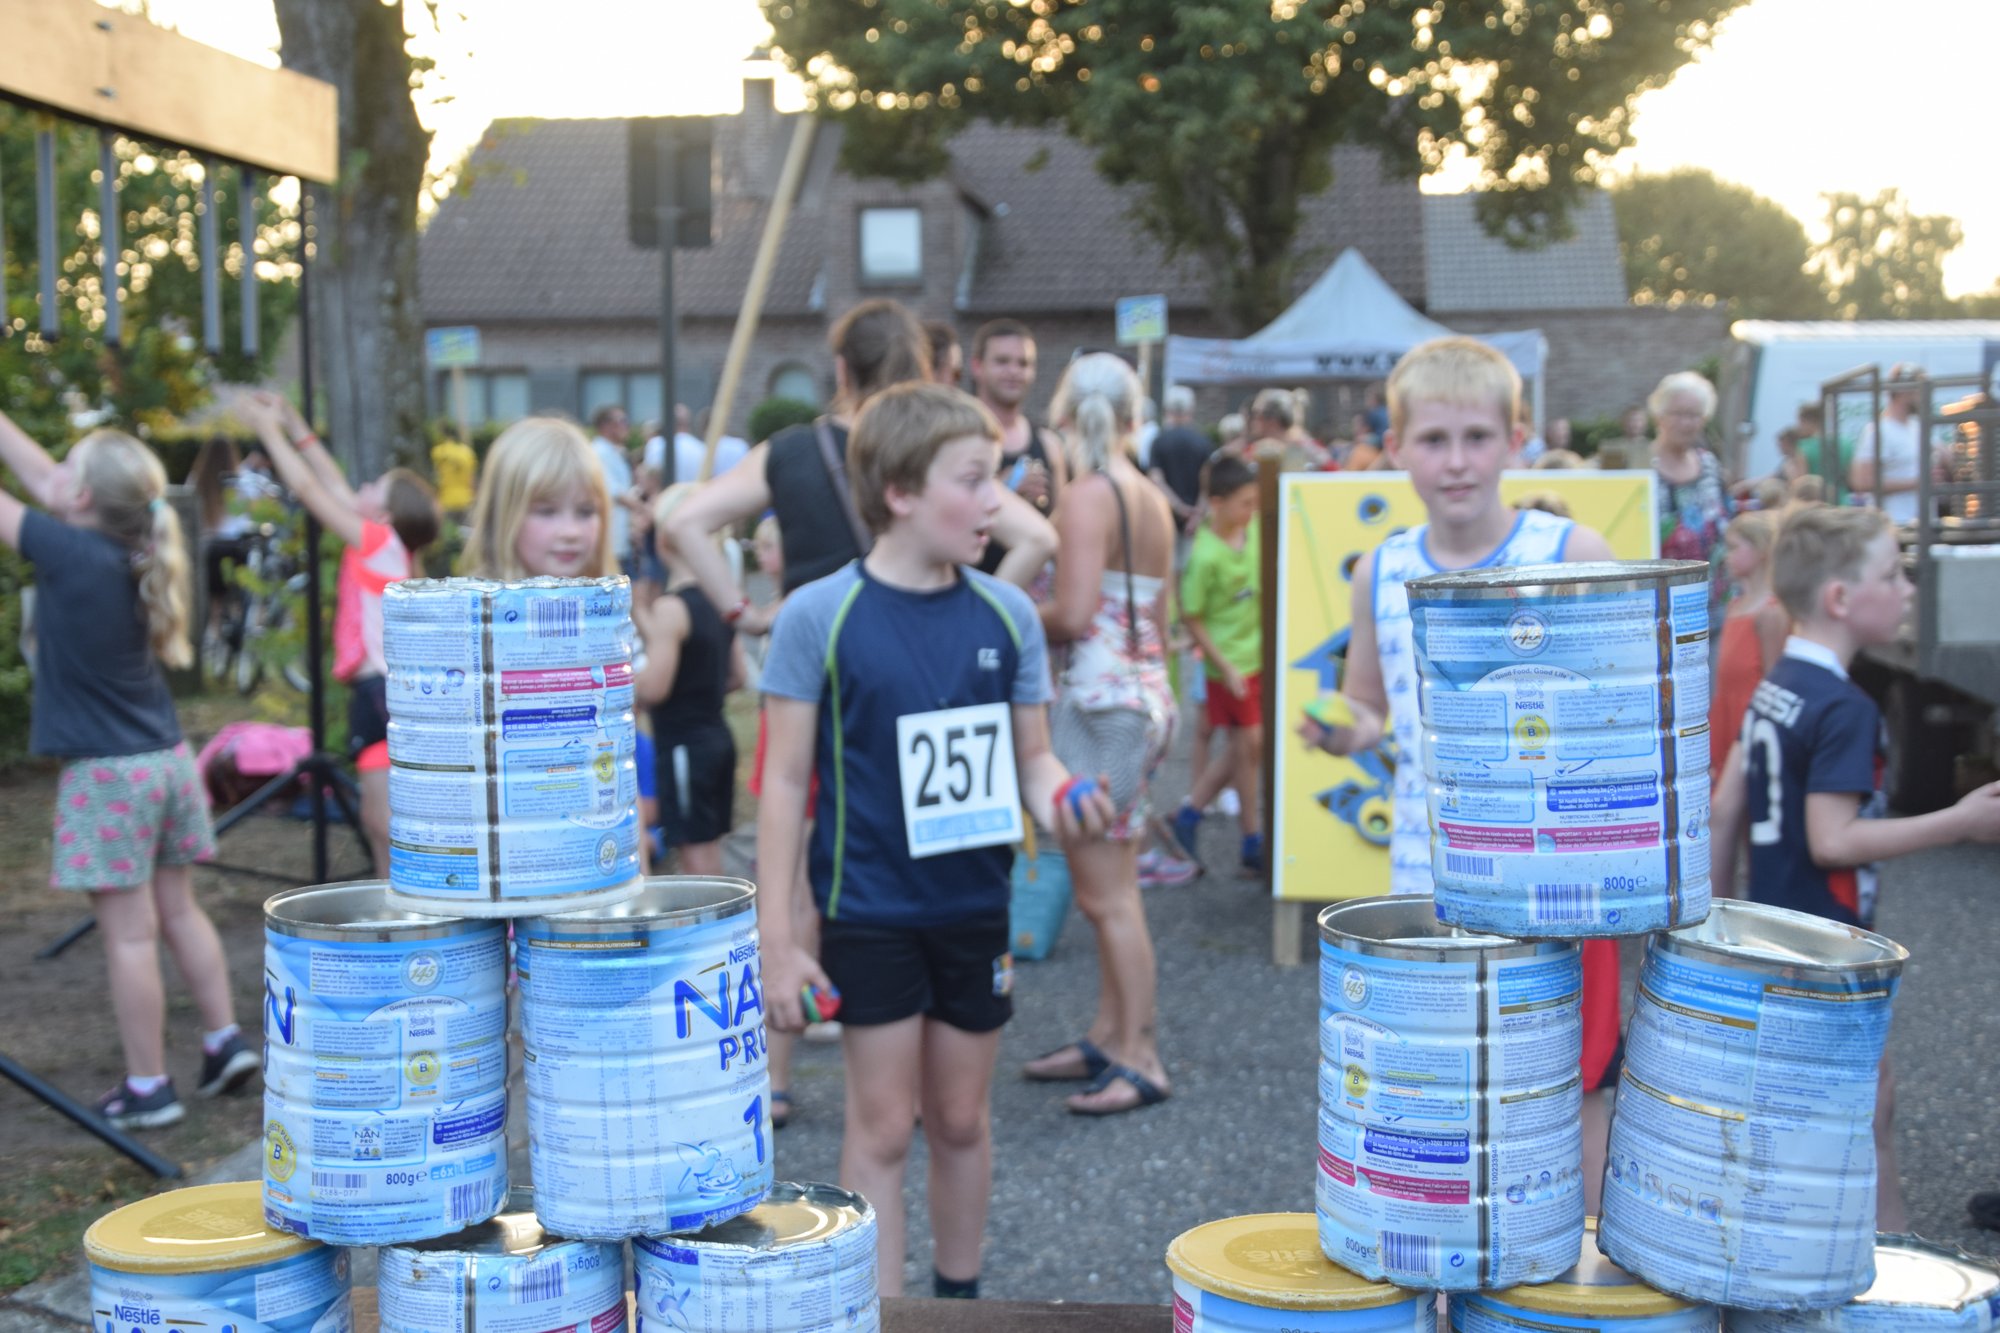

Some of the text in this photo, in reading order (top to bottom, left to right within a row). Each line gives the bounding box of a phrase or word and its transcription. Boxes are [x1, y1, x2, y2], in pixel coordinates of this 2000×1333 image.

[1515, 700, 1545, 710] Nestlé
[910, 721, 999, 808] 257
[1603, 876, 1635, 893] 800g
[729, 940, 757, 966] Nestlé
[410, 965, 436, 983] 145
[674, 956, 765, 1040] NA
[1344, 981, 1365, 995] 145
[354, 1131, 380, 1139] NAN
[743, 1094, 765, 1165] 1
[1491, 1143, 1499, 1186] 100233940
[385, 1172, 415, 1186] 800g
[114, 1304, 161, 1326] Nestlé
